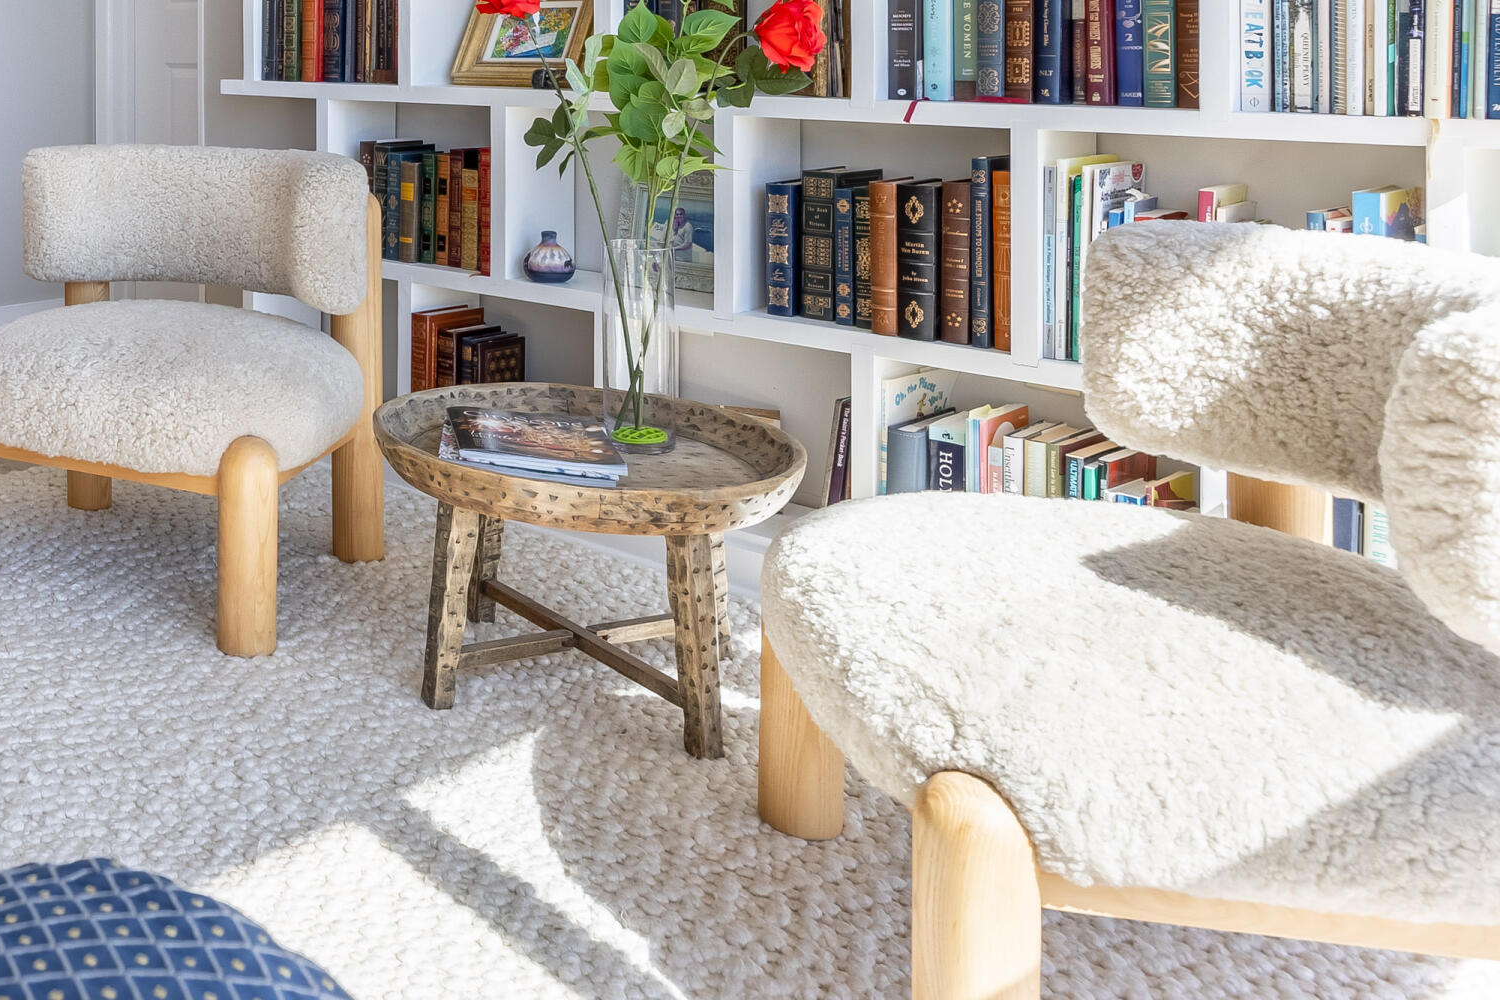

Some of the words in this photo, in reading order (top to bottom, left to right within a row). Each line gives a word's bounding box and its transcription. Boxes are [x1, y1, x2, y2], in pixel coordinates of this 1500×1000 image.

[963, 13, 972, 59] WOMEN
[1244, 23, 1264, 47] ART
[1302, 32, 1310, 64] QUEENIE
[1090, 46, 1102, 69] CHAMBERS
[1302, 64, 1310, 87] PEAVY
[975, 238, 982, 246] TO
[975, 247, 983, 277] CONQUER
[895, 393, 907, 406] Oh,
[919, 376, 936, 393] Places
[839, 435, 847, 453] Pocket
[1005, 446, 1014, 493] Unsettled
[1069, 462, 1078, 496] ULTIMATE
